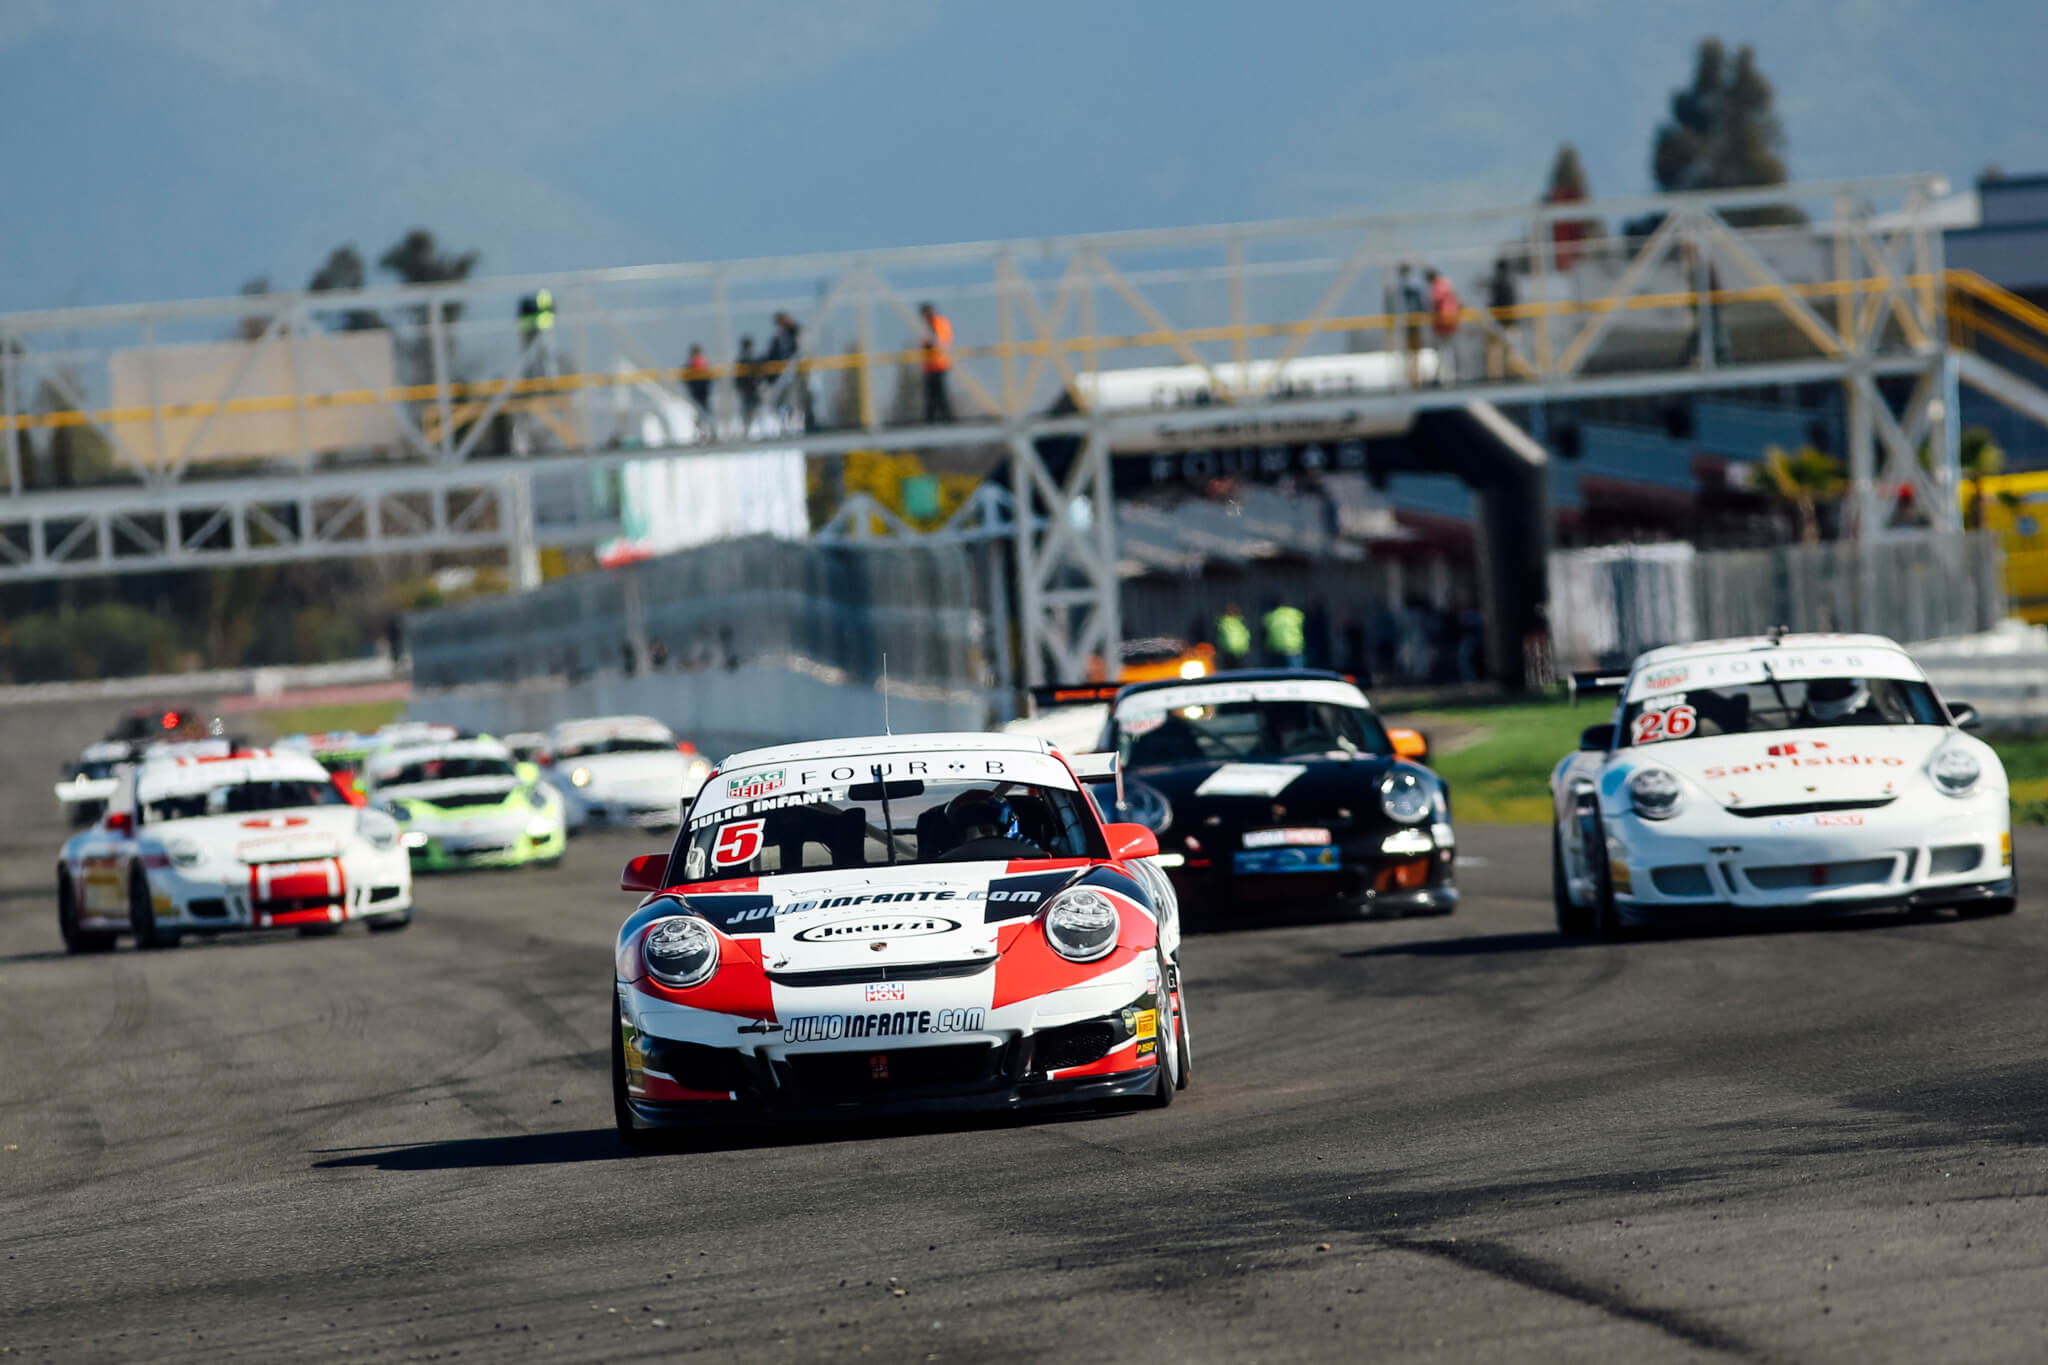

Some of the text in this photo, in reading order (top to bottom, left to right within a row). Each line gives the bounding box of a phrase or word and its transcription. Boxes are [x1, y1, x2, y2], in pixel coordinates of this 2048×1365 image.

[1635, 705, 1695, 745] 26
[733, 770, 783, 788] TAG
[801, 760, 1006, 786] FOUR B
[1703, 754, 1904, 779] San Isidro
[730, 780, 784, 798] HEUER
[689, 790, 845, 832] JULIO INFANTE
[713, 819, 764, 866] 5
[814, 919, 936, 939] Jacuzzi
[865, 992, 905, 1001] MOLY
